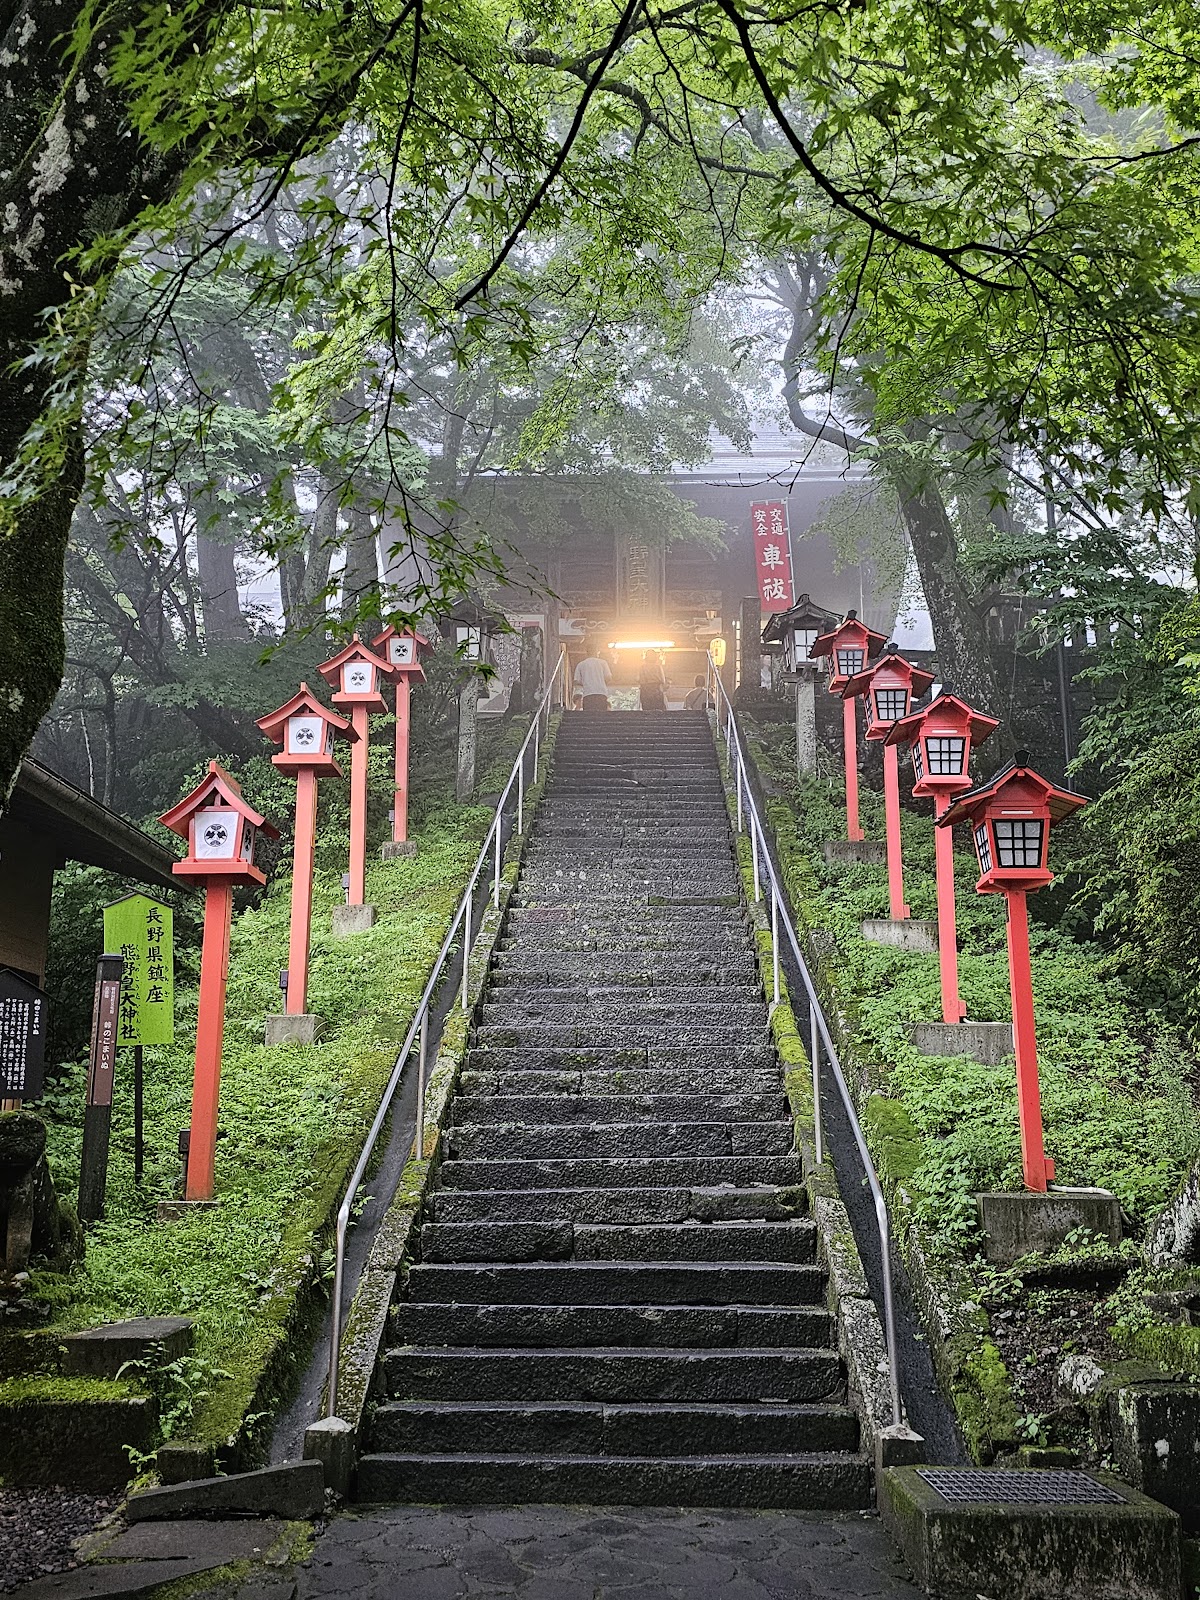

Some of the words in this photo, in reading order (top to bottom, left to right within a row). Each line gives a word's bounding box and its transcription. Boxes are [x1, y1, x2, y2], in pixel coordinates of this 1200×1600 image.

[753, 509, 768, 536] 安全
[770, 508, 784, 536] 交通
[761, 543, 788, 602] 車祓
[145, 906, 165, 1003] 長野県鎮座
[119, 943, 138, 1040] 熊野皇大神社
[33, 998, 42, 1035] 峠のこまいぬ
[100, 1021, 112, 1070] 峠のこまいぬ
